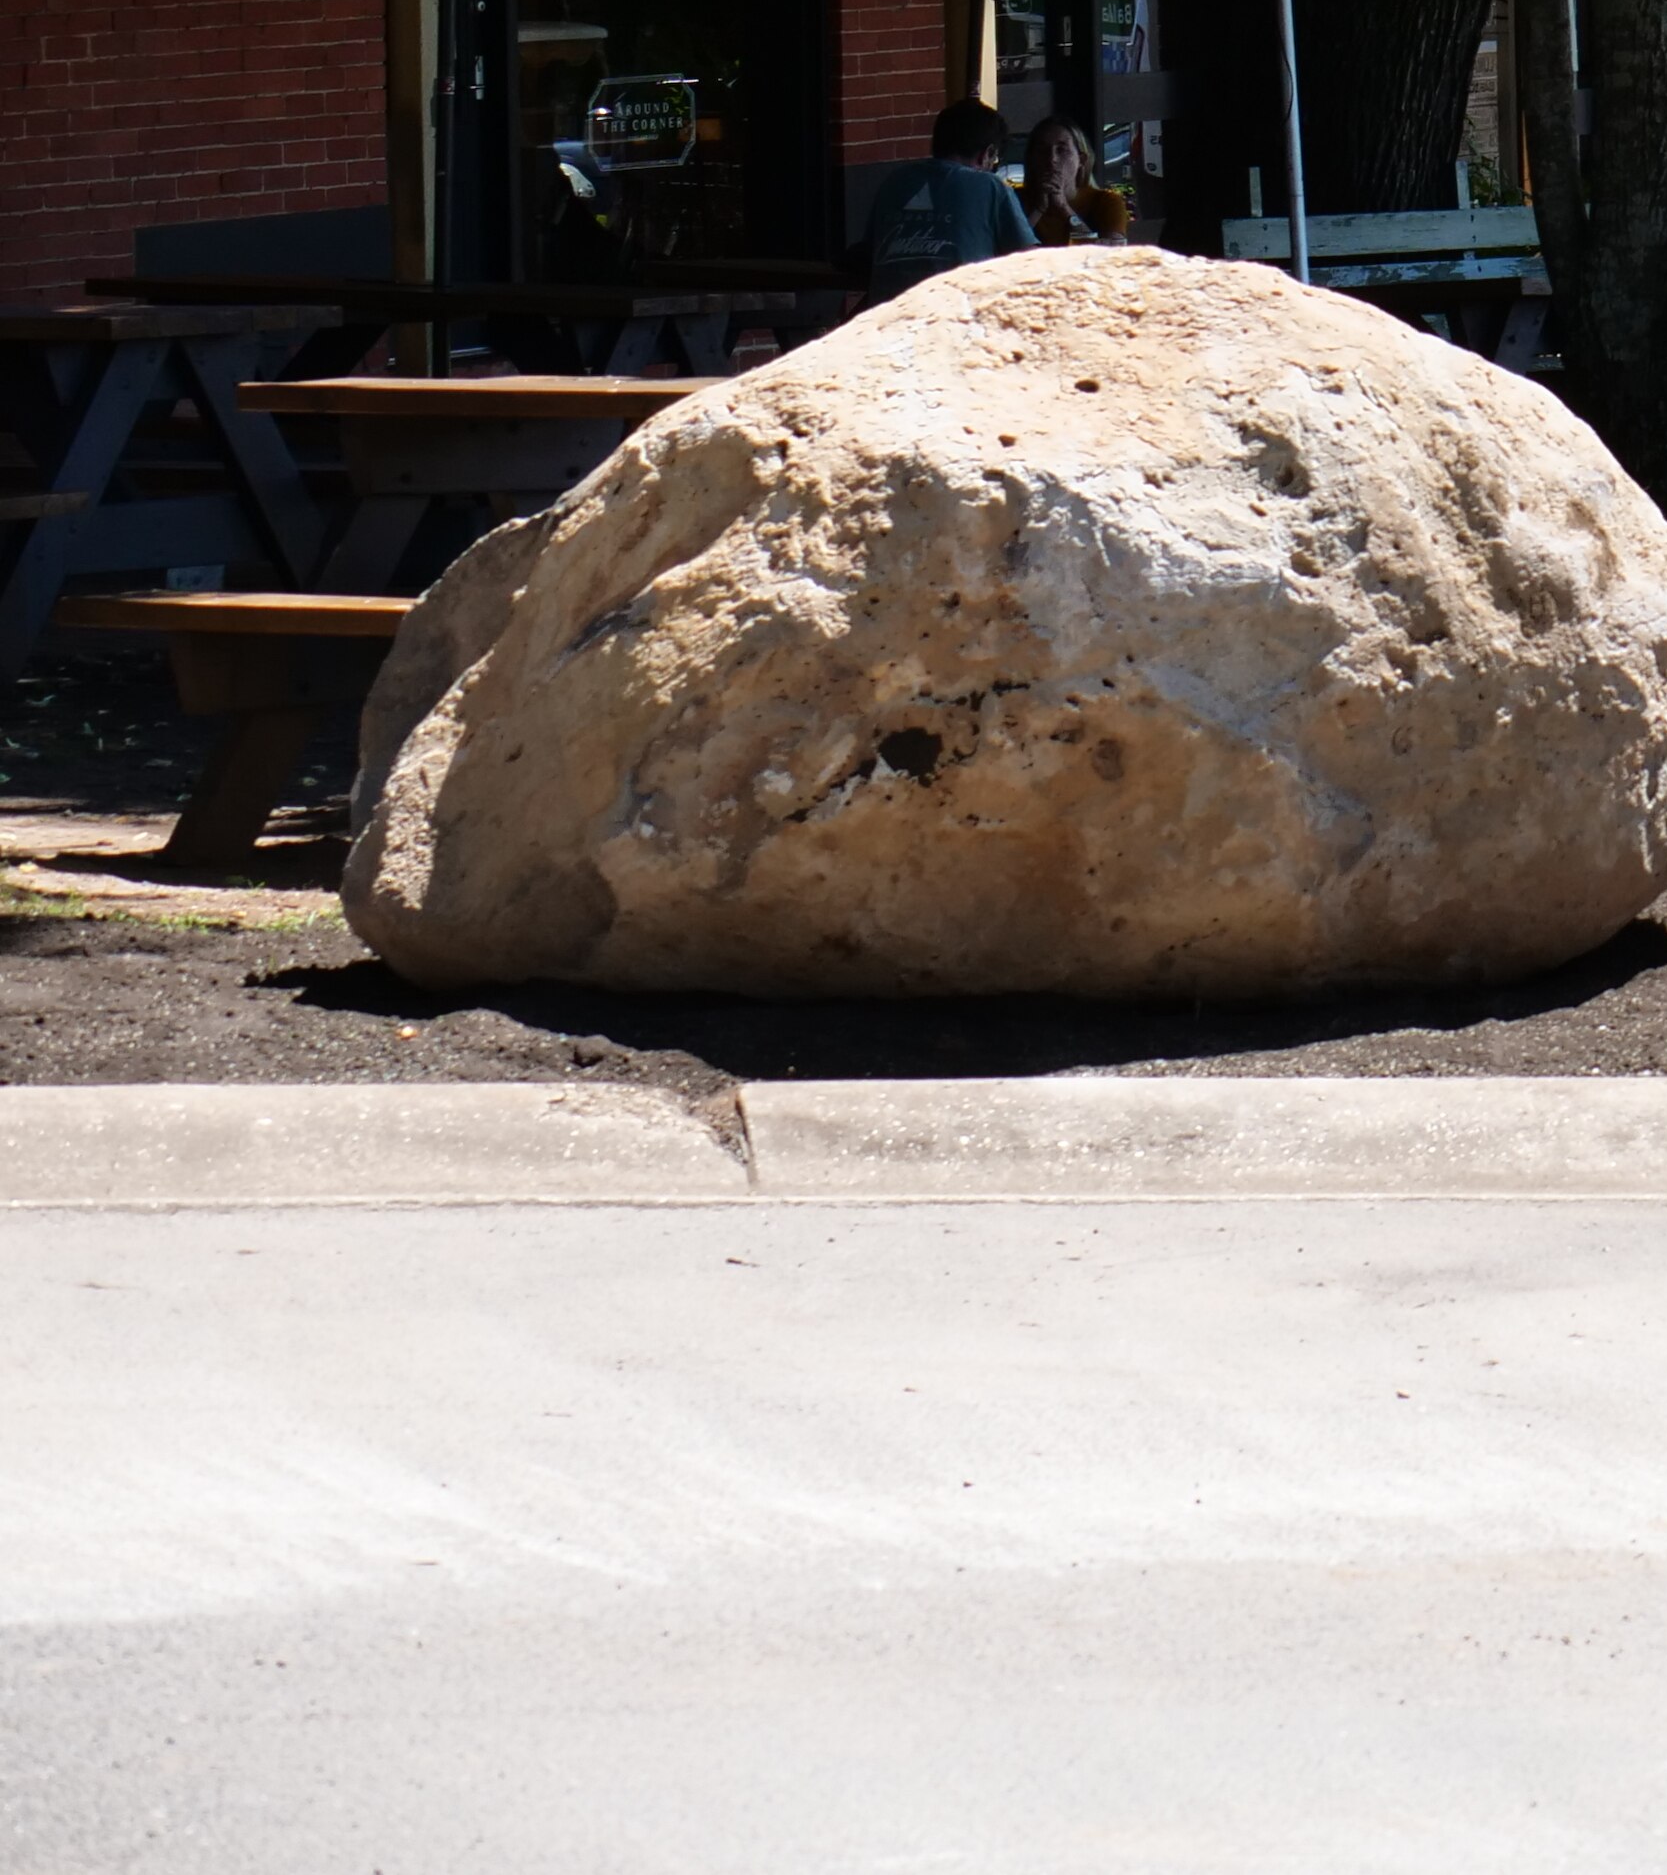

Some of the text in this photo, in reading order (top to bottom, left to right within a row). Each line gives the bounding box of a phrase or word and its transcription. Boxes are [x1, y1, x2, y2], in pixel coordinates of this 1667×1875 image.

[615, 102, 670, 117] AROUND
[602, 116, 684, 133] THE CORNER
